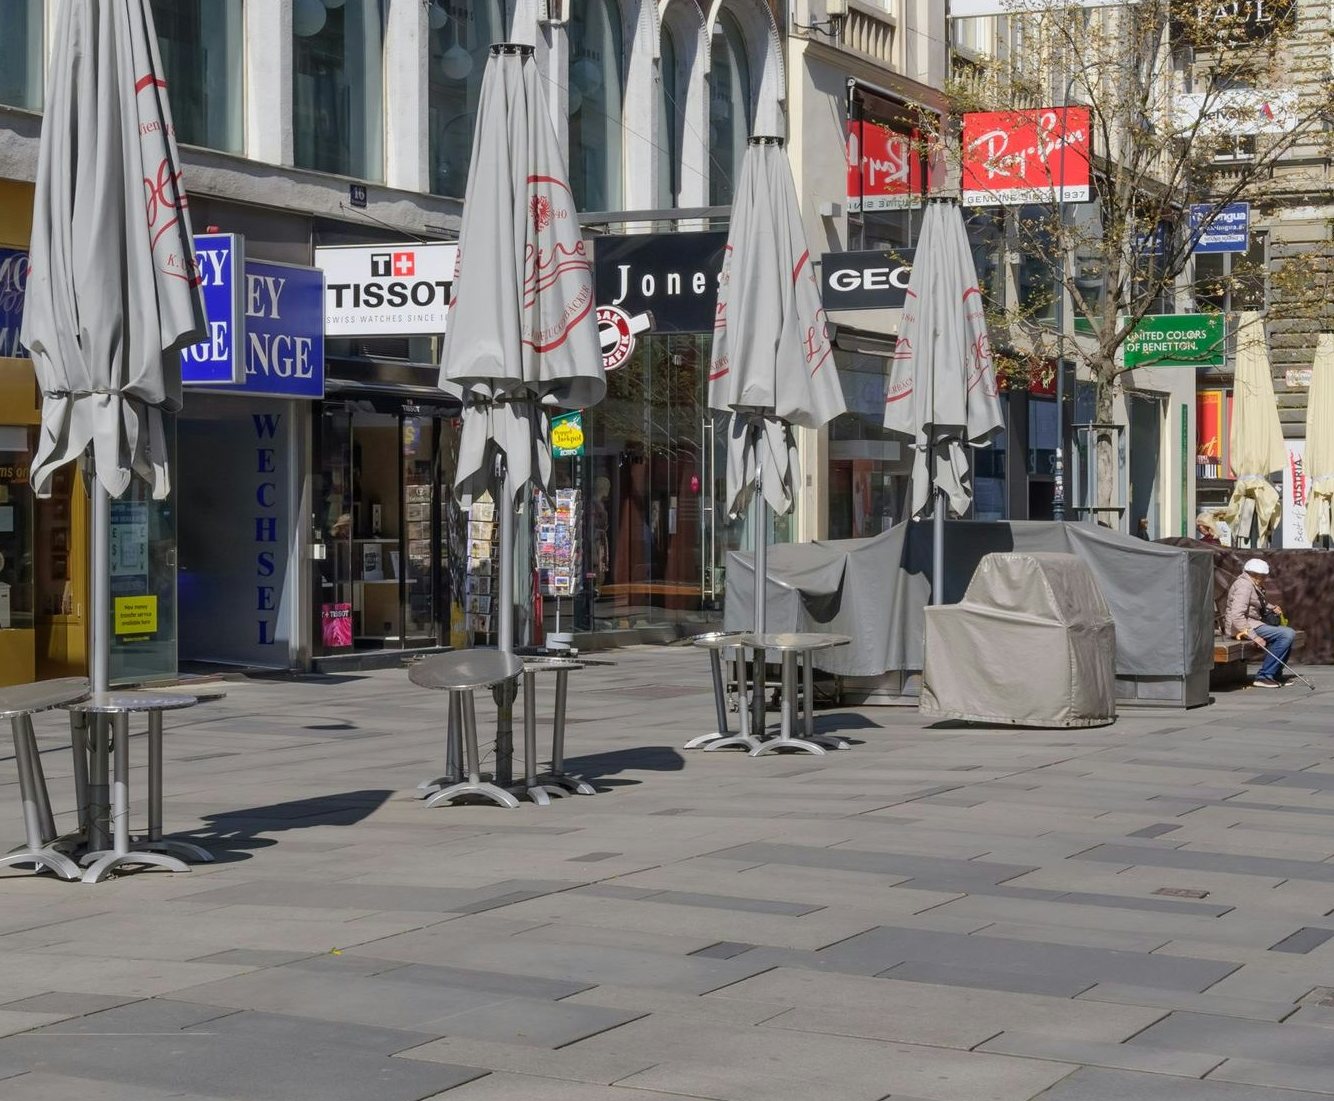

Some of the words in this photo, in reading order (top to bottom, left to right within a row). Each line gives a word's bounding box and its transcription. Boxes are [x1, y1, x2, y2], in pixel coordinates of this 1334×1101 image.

[966, 111, 1086, 181] Ray-Ban
[354, 186, 365, 201] 16
[967, 192, 1017, 204] GENUINE
[327, 281, 453, 309] TISSOT
[326, 315, 356, 325] SWISS
[360, 314, 403, 324] WATCHES
[407, 314, 435, 323] SINCE
[1127, 331, 1164, 342] UNITED
[1167, 330, 1207, 341] COLORS
[246, 332, 313, 379] NGE
[1126, 343, 1141, 353] OF
[556, 433, 582, 444] Jackpot
[1293, 459, 1303, 507] AUSTRIA
[251, 413, 282, 646] WECHSEL
